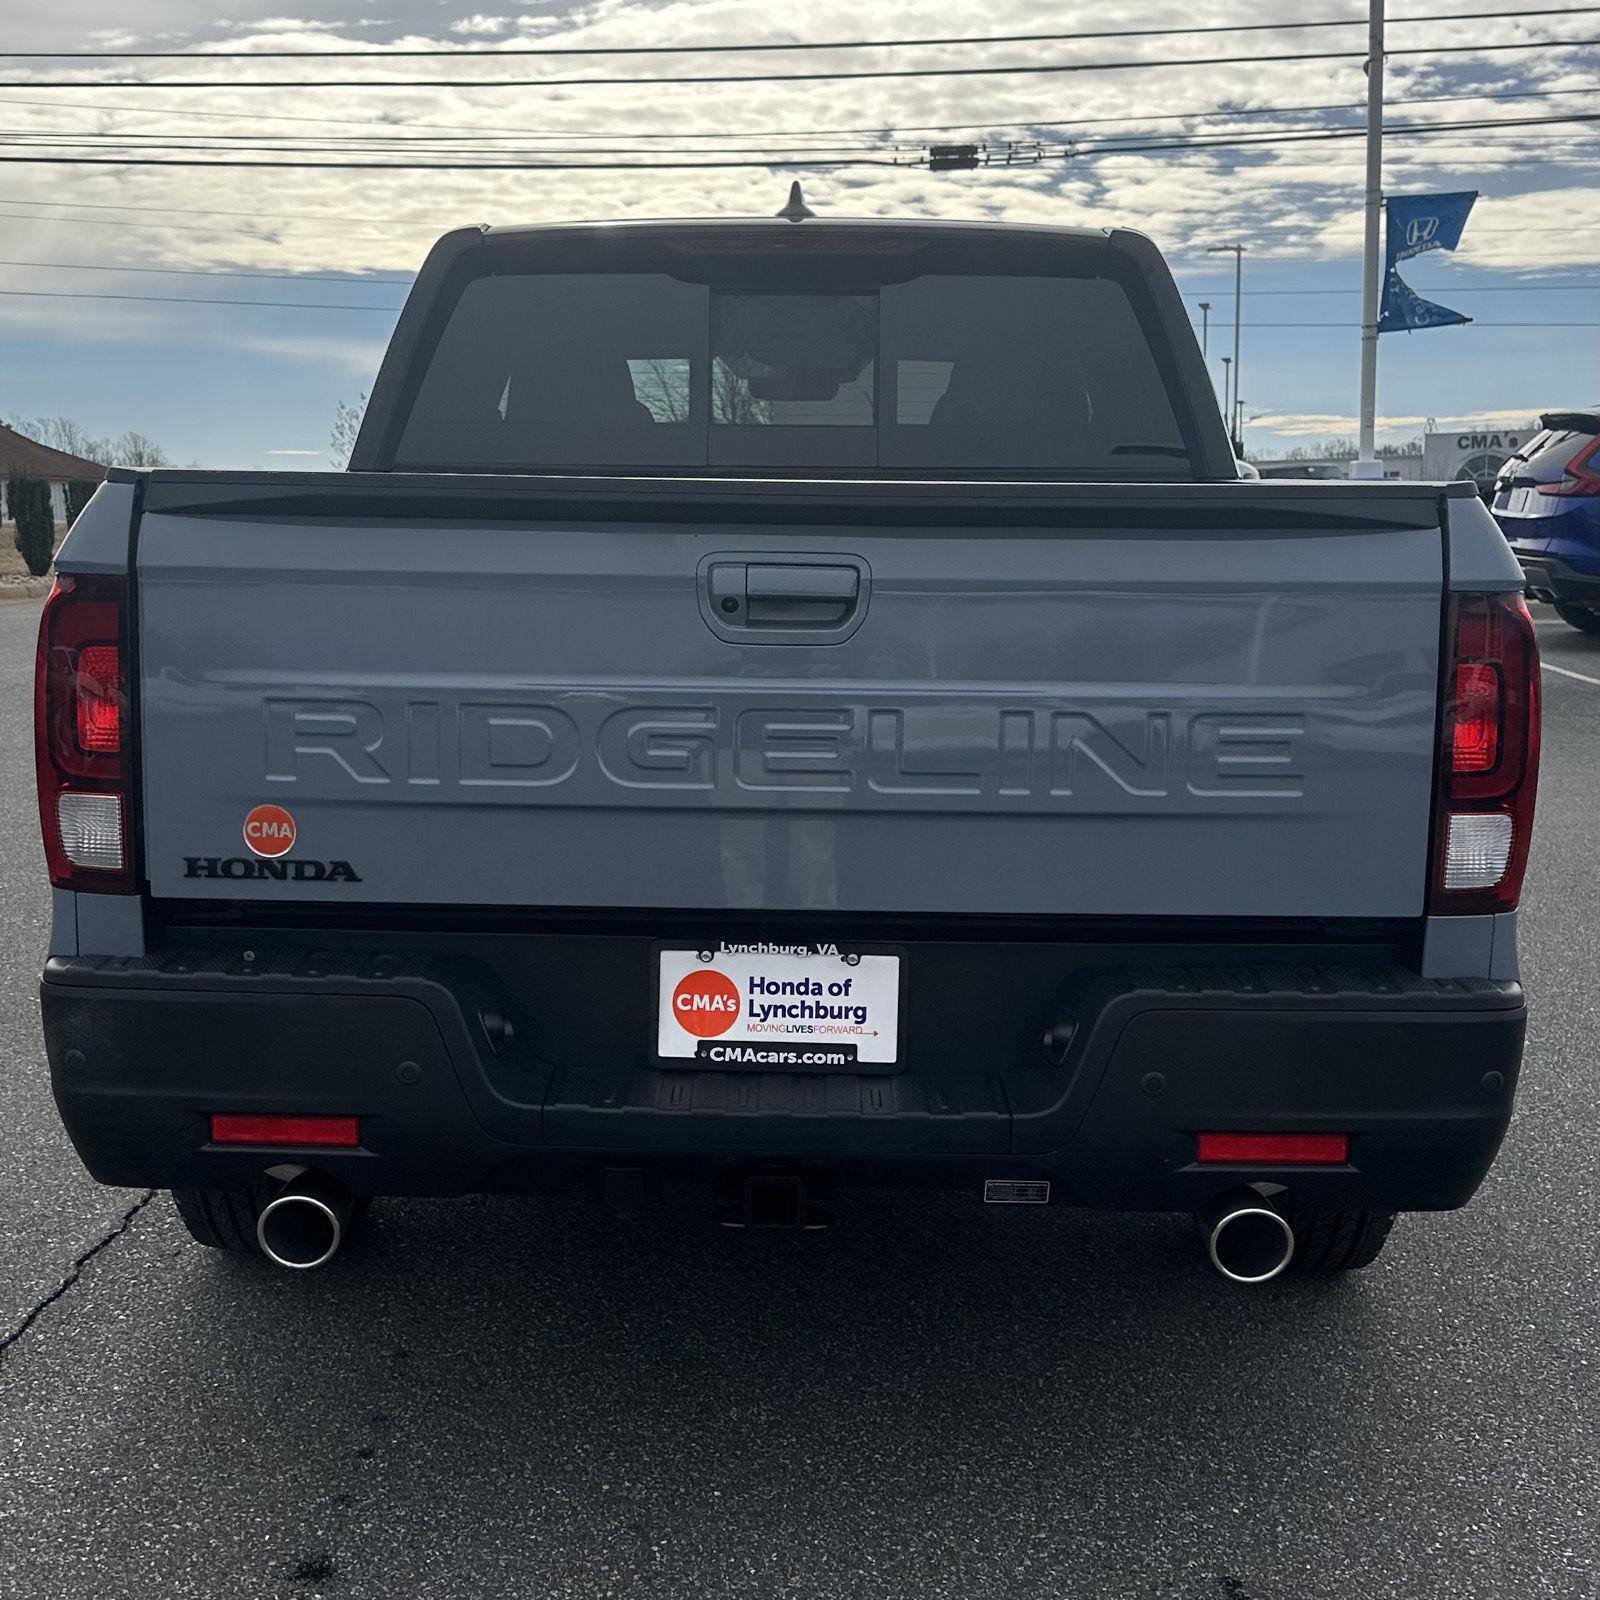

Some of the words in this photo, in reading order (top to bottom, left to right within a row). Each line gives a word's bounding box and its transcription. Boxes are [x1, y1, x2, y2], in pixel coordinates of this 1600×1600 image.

[1457, 432, 1518, 450] CMA's
[263, 696, 1305, 799] RIDGELINE
[247, 821, 293, 838] CMA
[183, 856, 363, 882] HONDA
[720, 941, 812, 957] Lynchburg,
[816, 943, 839, 956] VA
[748, 976, 822, 997] Honda
[828, 978, 852, 997] of
[676, 993, 737, 1012] CMA's
[748, 999, 867, 1024] Lynchburg
[709, 1046, 845, 1065] CMAcars.com
